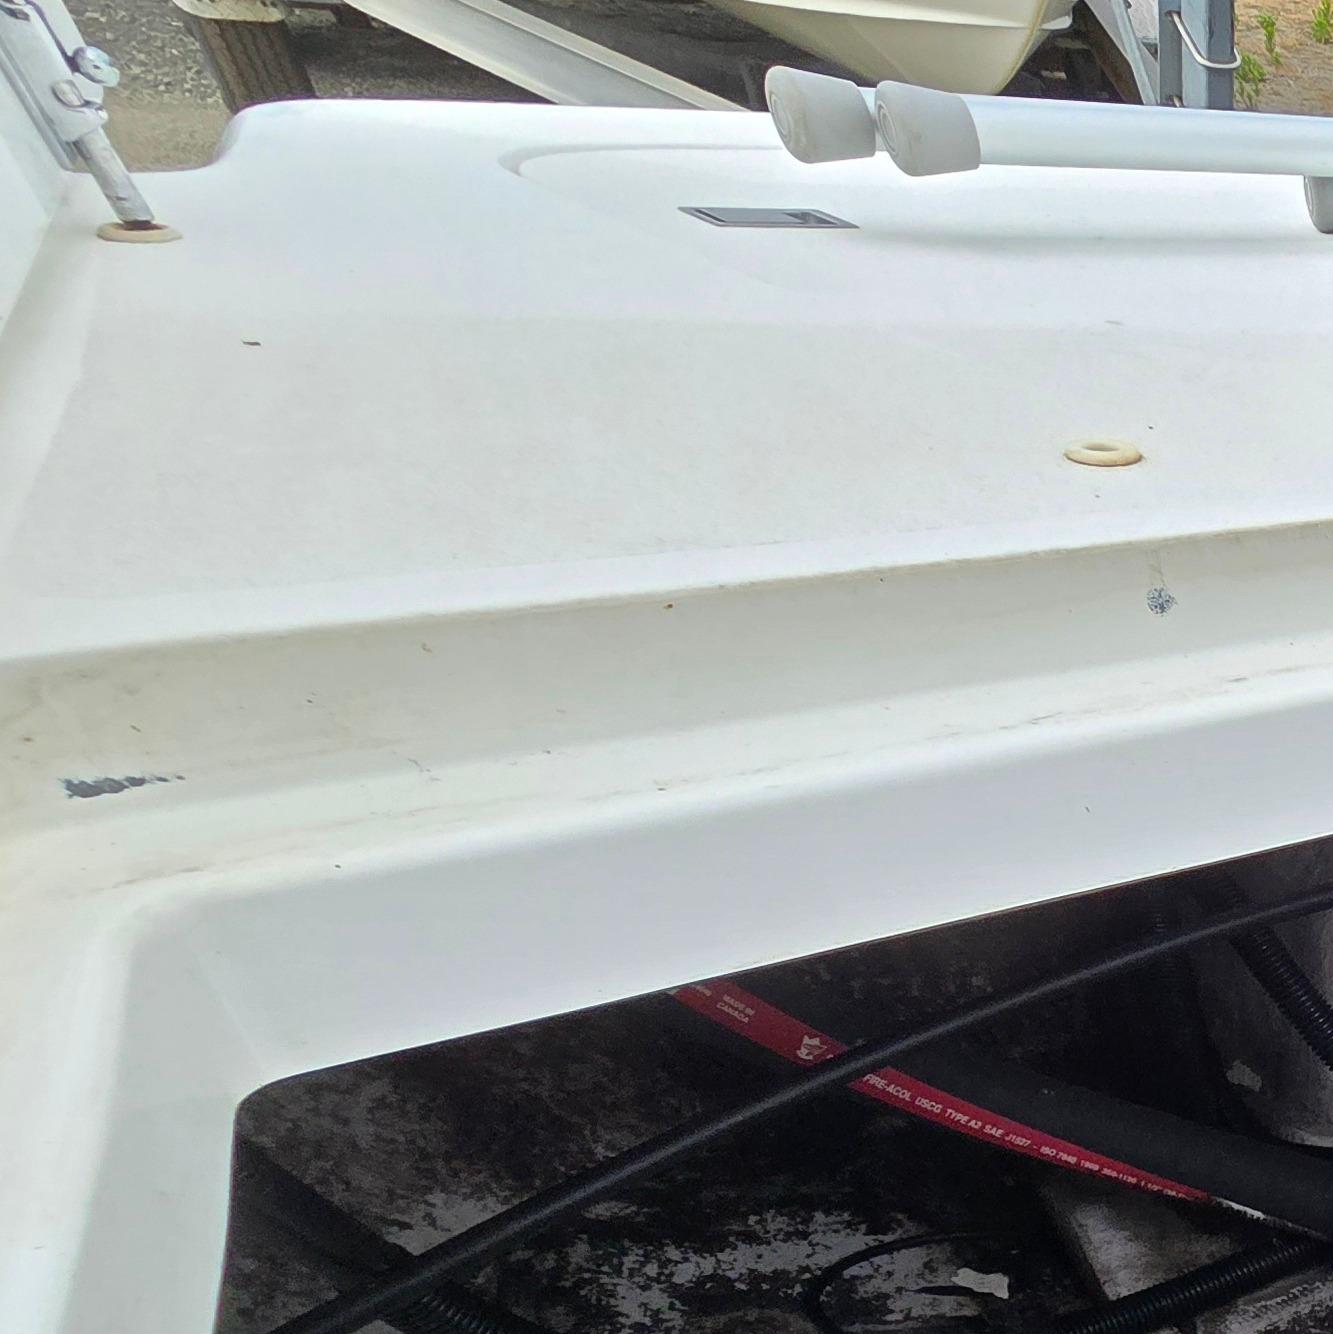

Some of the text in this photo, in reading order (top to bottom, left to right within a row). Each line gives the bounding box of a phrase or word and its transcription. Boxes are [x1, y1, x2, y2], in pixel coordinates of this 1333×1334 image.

[863, 1073, 912, 1101] FIRE-ACOL
[914, 1095, 942, 1113] USCG
[943, 1108, 970, 1125] TYPE
[982, 1123, 1004, 1138] SAE
